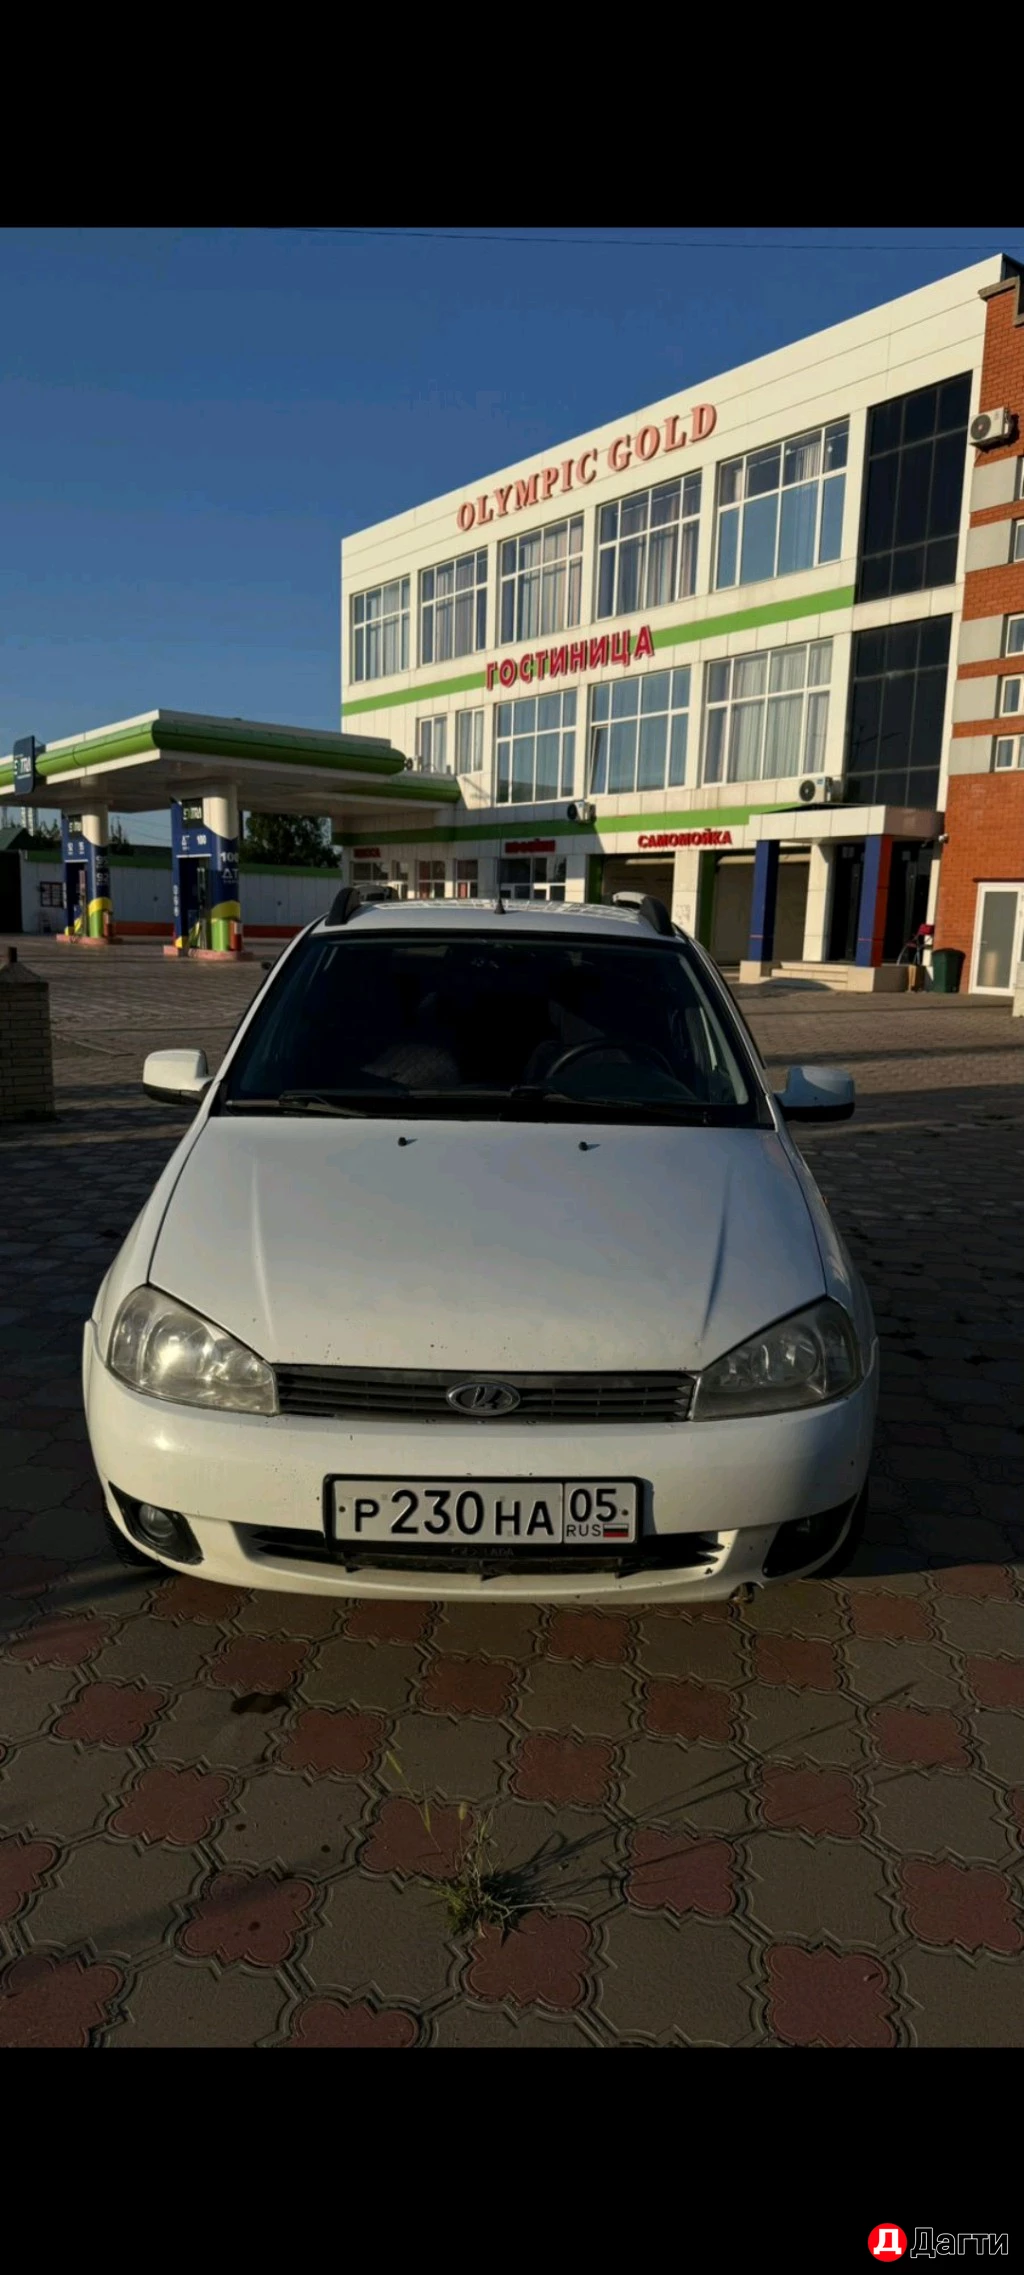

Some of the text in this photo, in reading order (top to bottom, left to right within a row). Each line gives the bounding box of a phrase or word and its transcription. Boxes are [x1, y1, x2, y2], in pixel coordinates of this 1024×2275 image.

[457, 402, 718, 531] OLYMPIC GOLD
[486, 624, 656, 692] ГОСТИНИЦА
[637, 828, 733, 848] САМОМОЙКА
[569, 1488, 617, 1522] 05
[566, 1524, 601, 1537] RUS
